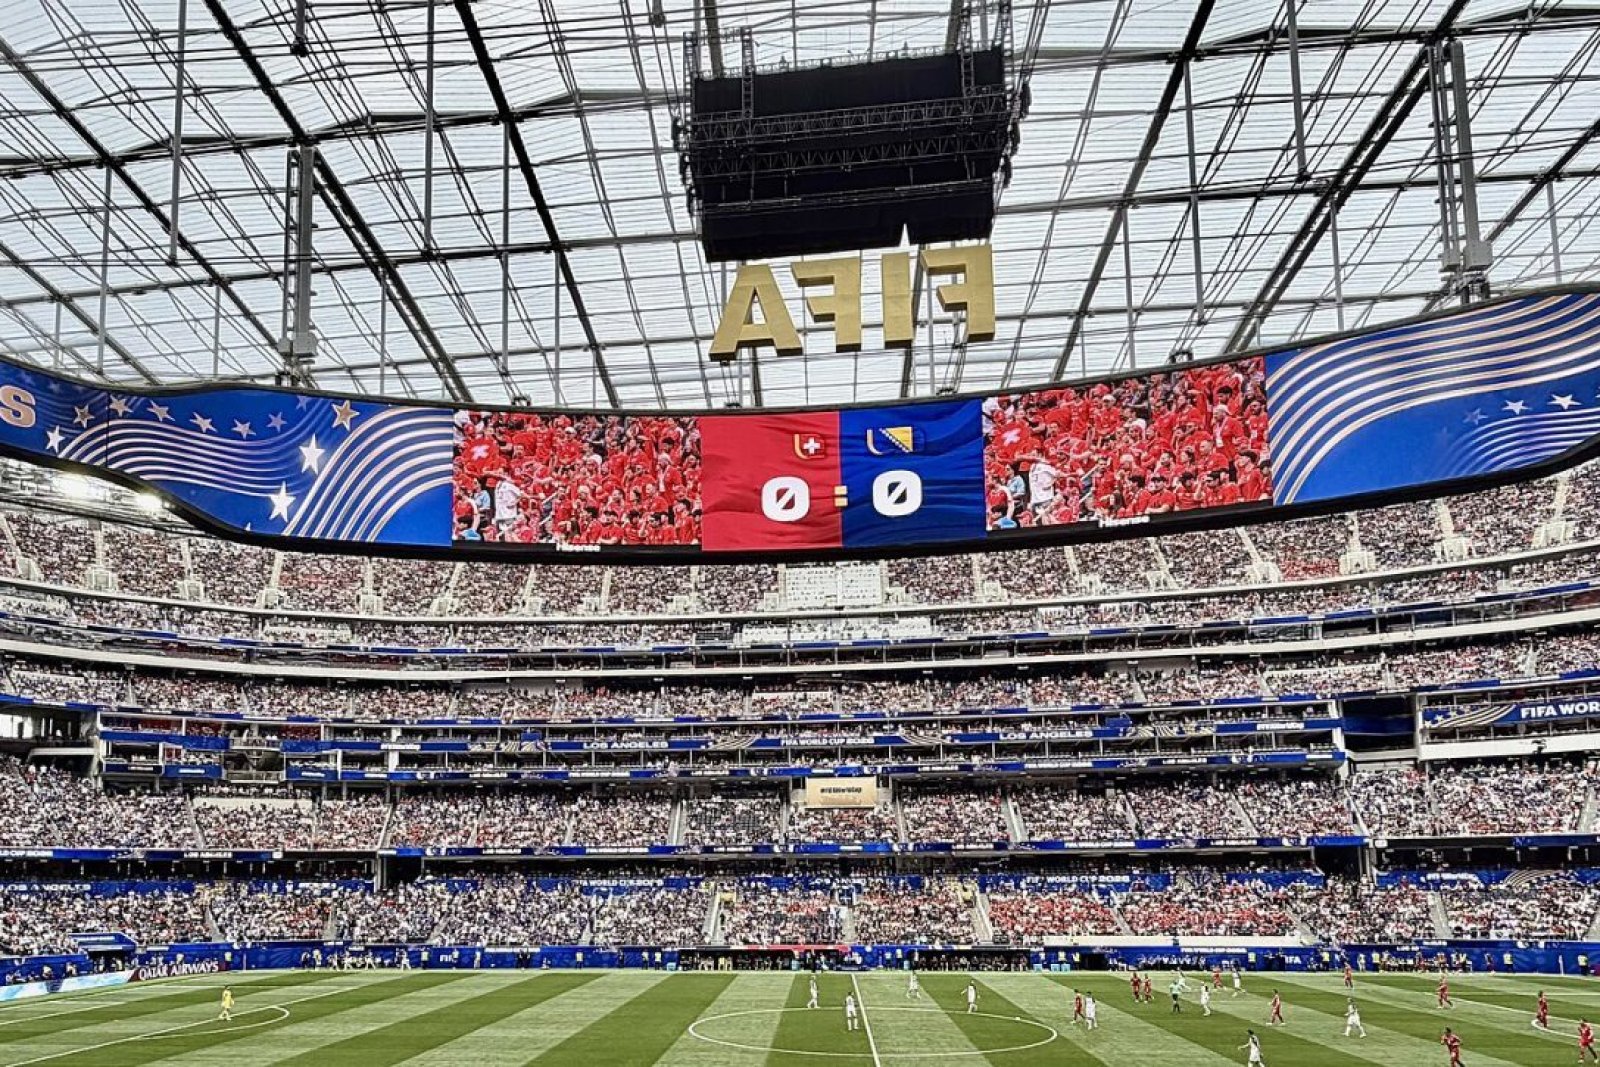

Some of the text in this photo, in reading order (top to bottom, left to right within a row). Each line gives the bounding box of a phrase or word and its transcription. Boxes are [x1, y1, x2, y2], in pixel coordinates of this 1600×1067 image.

[762, 470, 922, 522] 0 0
[1521, 705, 1557, 719] FIFA
[1000, 730, 1093, 740] LOS ANGELES
[610, 741, 668, 749] ANGELES
[139, 960, 219, 981] QATAR AIRWAYS
